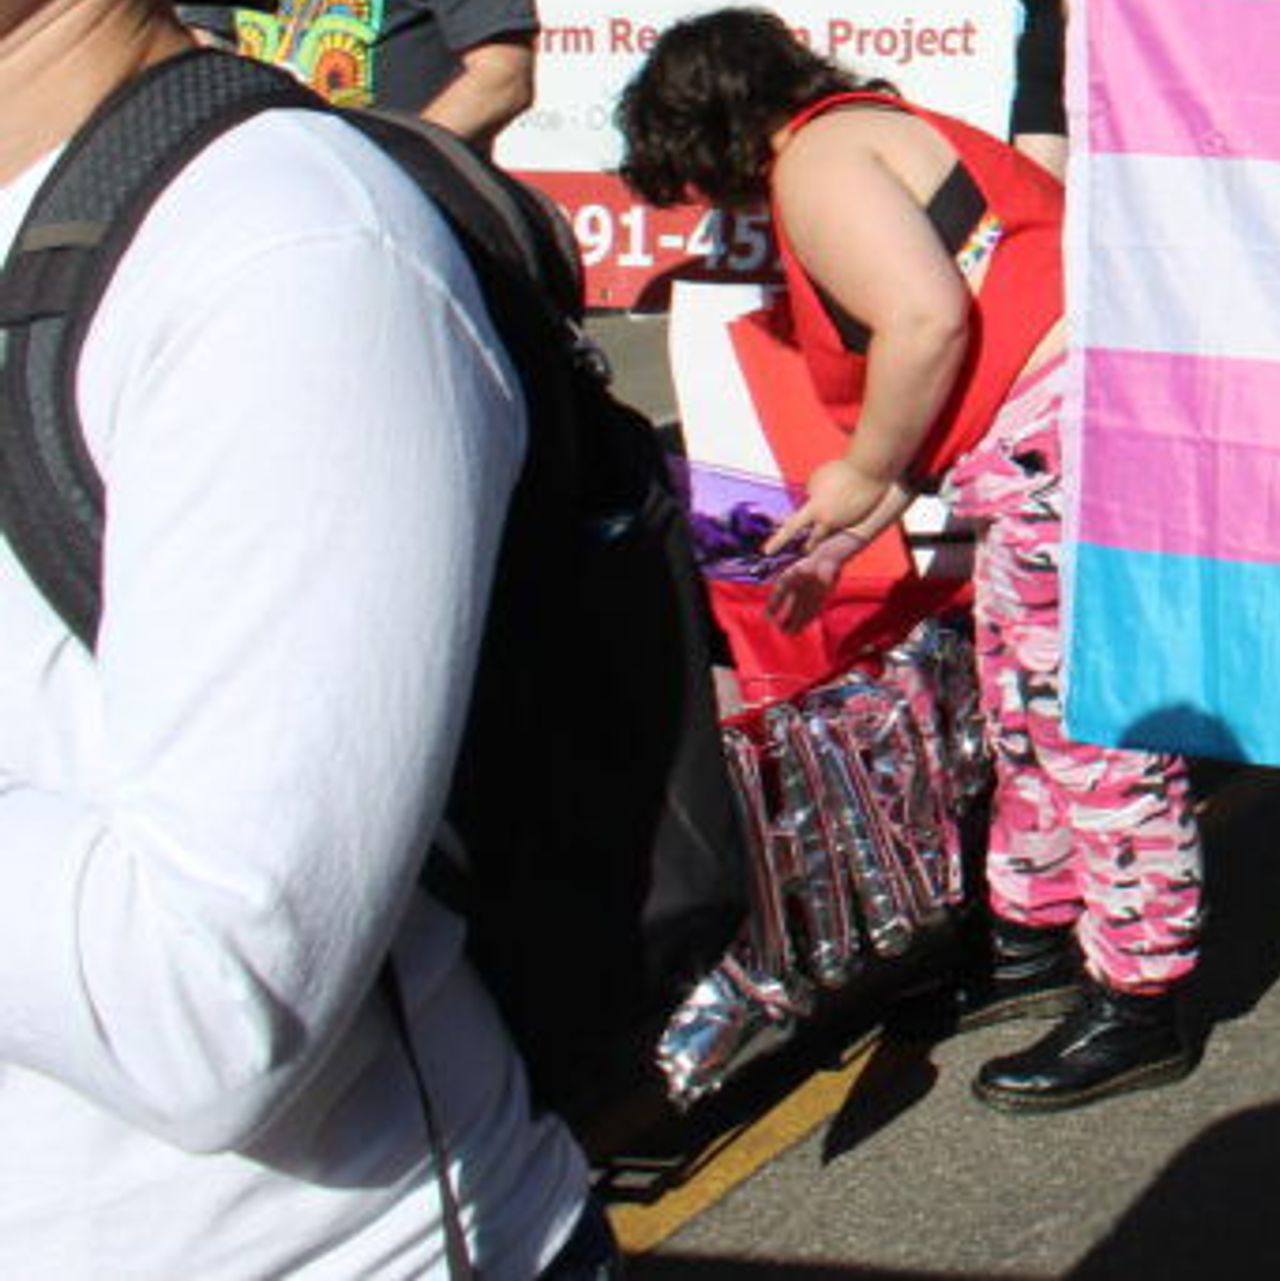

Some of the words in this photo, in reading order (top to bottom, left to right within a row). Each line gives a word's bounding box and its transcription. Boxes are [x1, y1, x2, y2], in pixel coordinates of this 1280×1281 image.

[542, 26, 594, 53] rm
[828, 18, 976, 66] Project
[560, 203, 779, 271] 91-45
